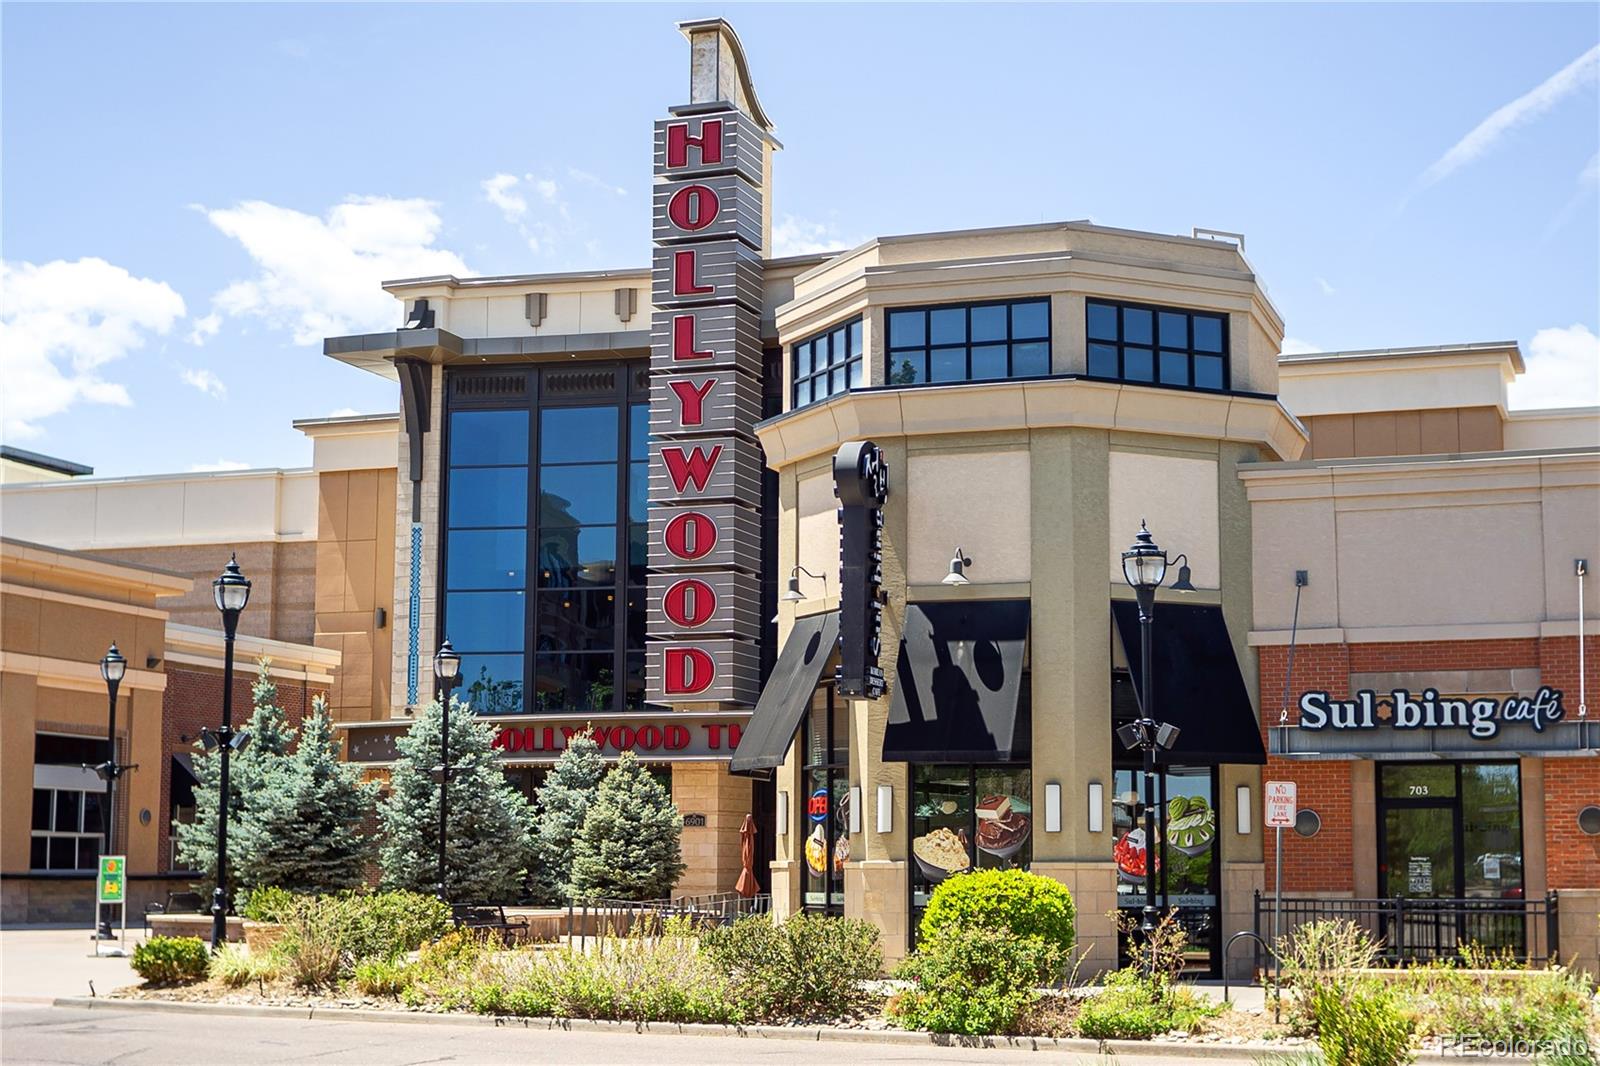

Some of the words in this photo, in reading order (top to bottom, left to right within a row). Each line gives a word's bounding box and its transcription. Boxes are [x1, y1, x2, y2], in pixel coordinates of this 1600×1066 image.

[660, 118, 725, 695] HOLLYWOOD
[1503, 688, 1562, 730] café
[491, 725, 691, 753] OLLYWOOD
[1275, 786, 1287, 794] NO
[1409, 786, 1429, 795] 703
[1268, 795, 1293, 804] PARKING
[685, 817, 704, 826] 6901
